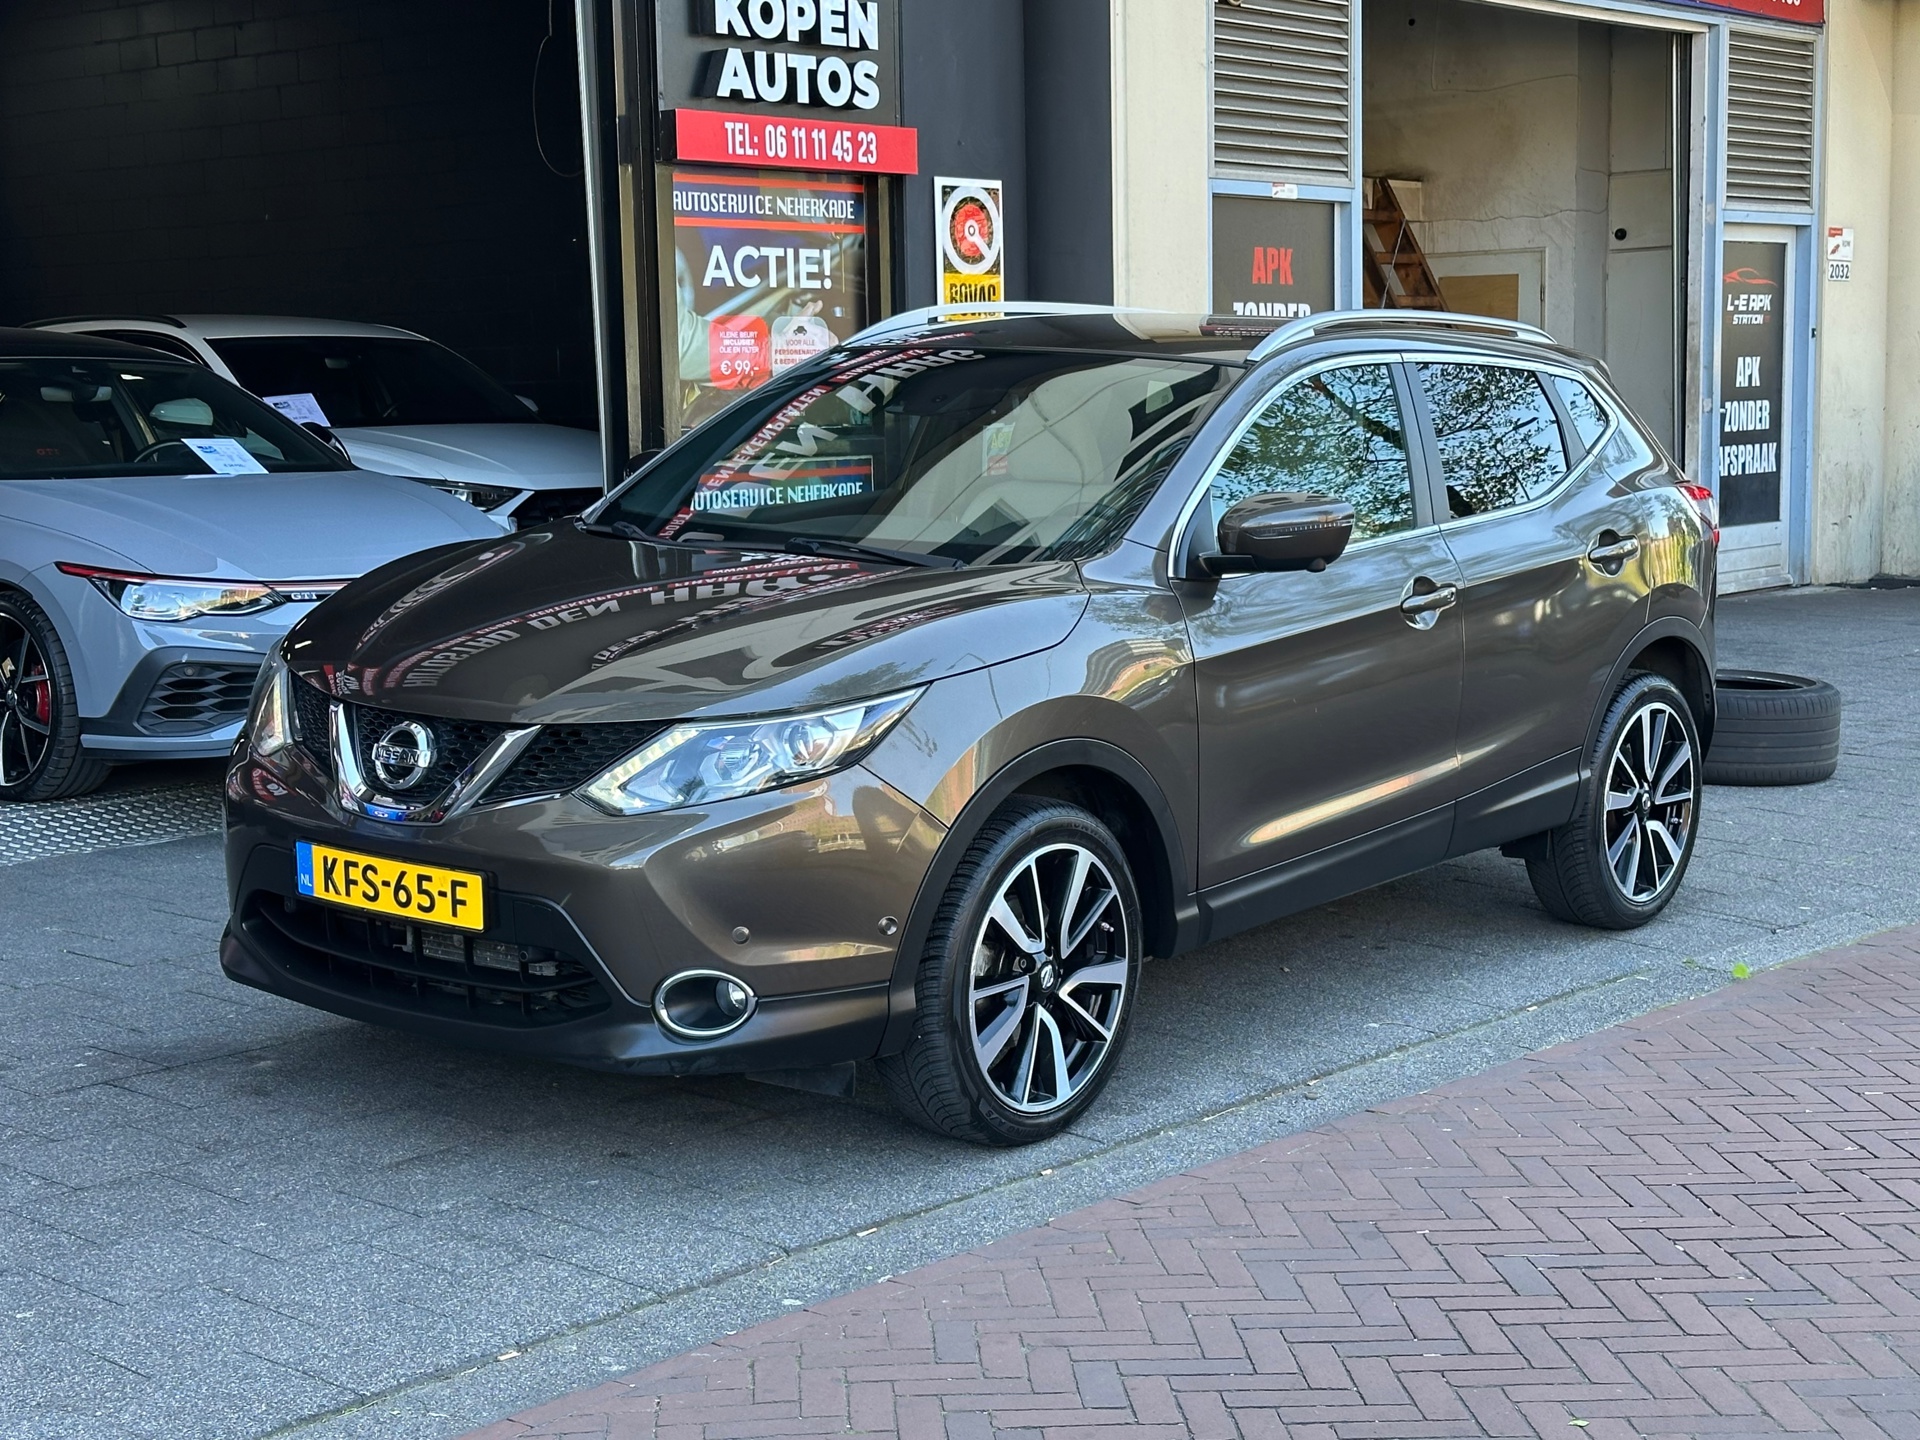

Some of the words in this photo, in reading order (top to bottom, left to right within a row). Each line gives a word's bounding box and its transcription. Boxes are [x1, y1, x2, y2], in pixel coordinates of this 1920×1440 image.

[714, 0, 879, 50] KOPEN
[716, 47, 880, 109] AUTOS
[724, 121, 758, 156] TEL:
[765, 124, 787, 158] 06
[791, 127, 807, 159] 11
[811, 128, 827, 160] 11
[832, 130, 852, 162] 45
[857, 131, 877, 164] 23
[673, 191, 773, 215] AUTOSERVICE
[776, 196, 855, 219] NEHERKADE
[702, 245, 832, 290] ACTIE!
[1252, 247, 1293, 285] APK
[1829, 263, 1850, 279] 2032
[1727, 294, 1748, 311] L-E
[1749, 294, 1772, 311] APK
[1732, 314, 1764, 325] STATION
[720, 360, 731, 375] €
[734, 360, 759, 376] 99,-
[1736, 356, 1761, 388] APK
[1724, 400, 1770, 432] ZONDER
[291, 591, 318, 600] GTI
[378, 745, 420, 764] NISSAN
[300, 873, 312, 887] NL
[322, 854, 468, 918] KFS-65-F
